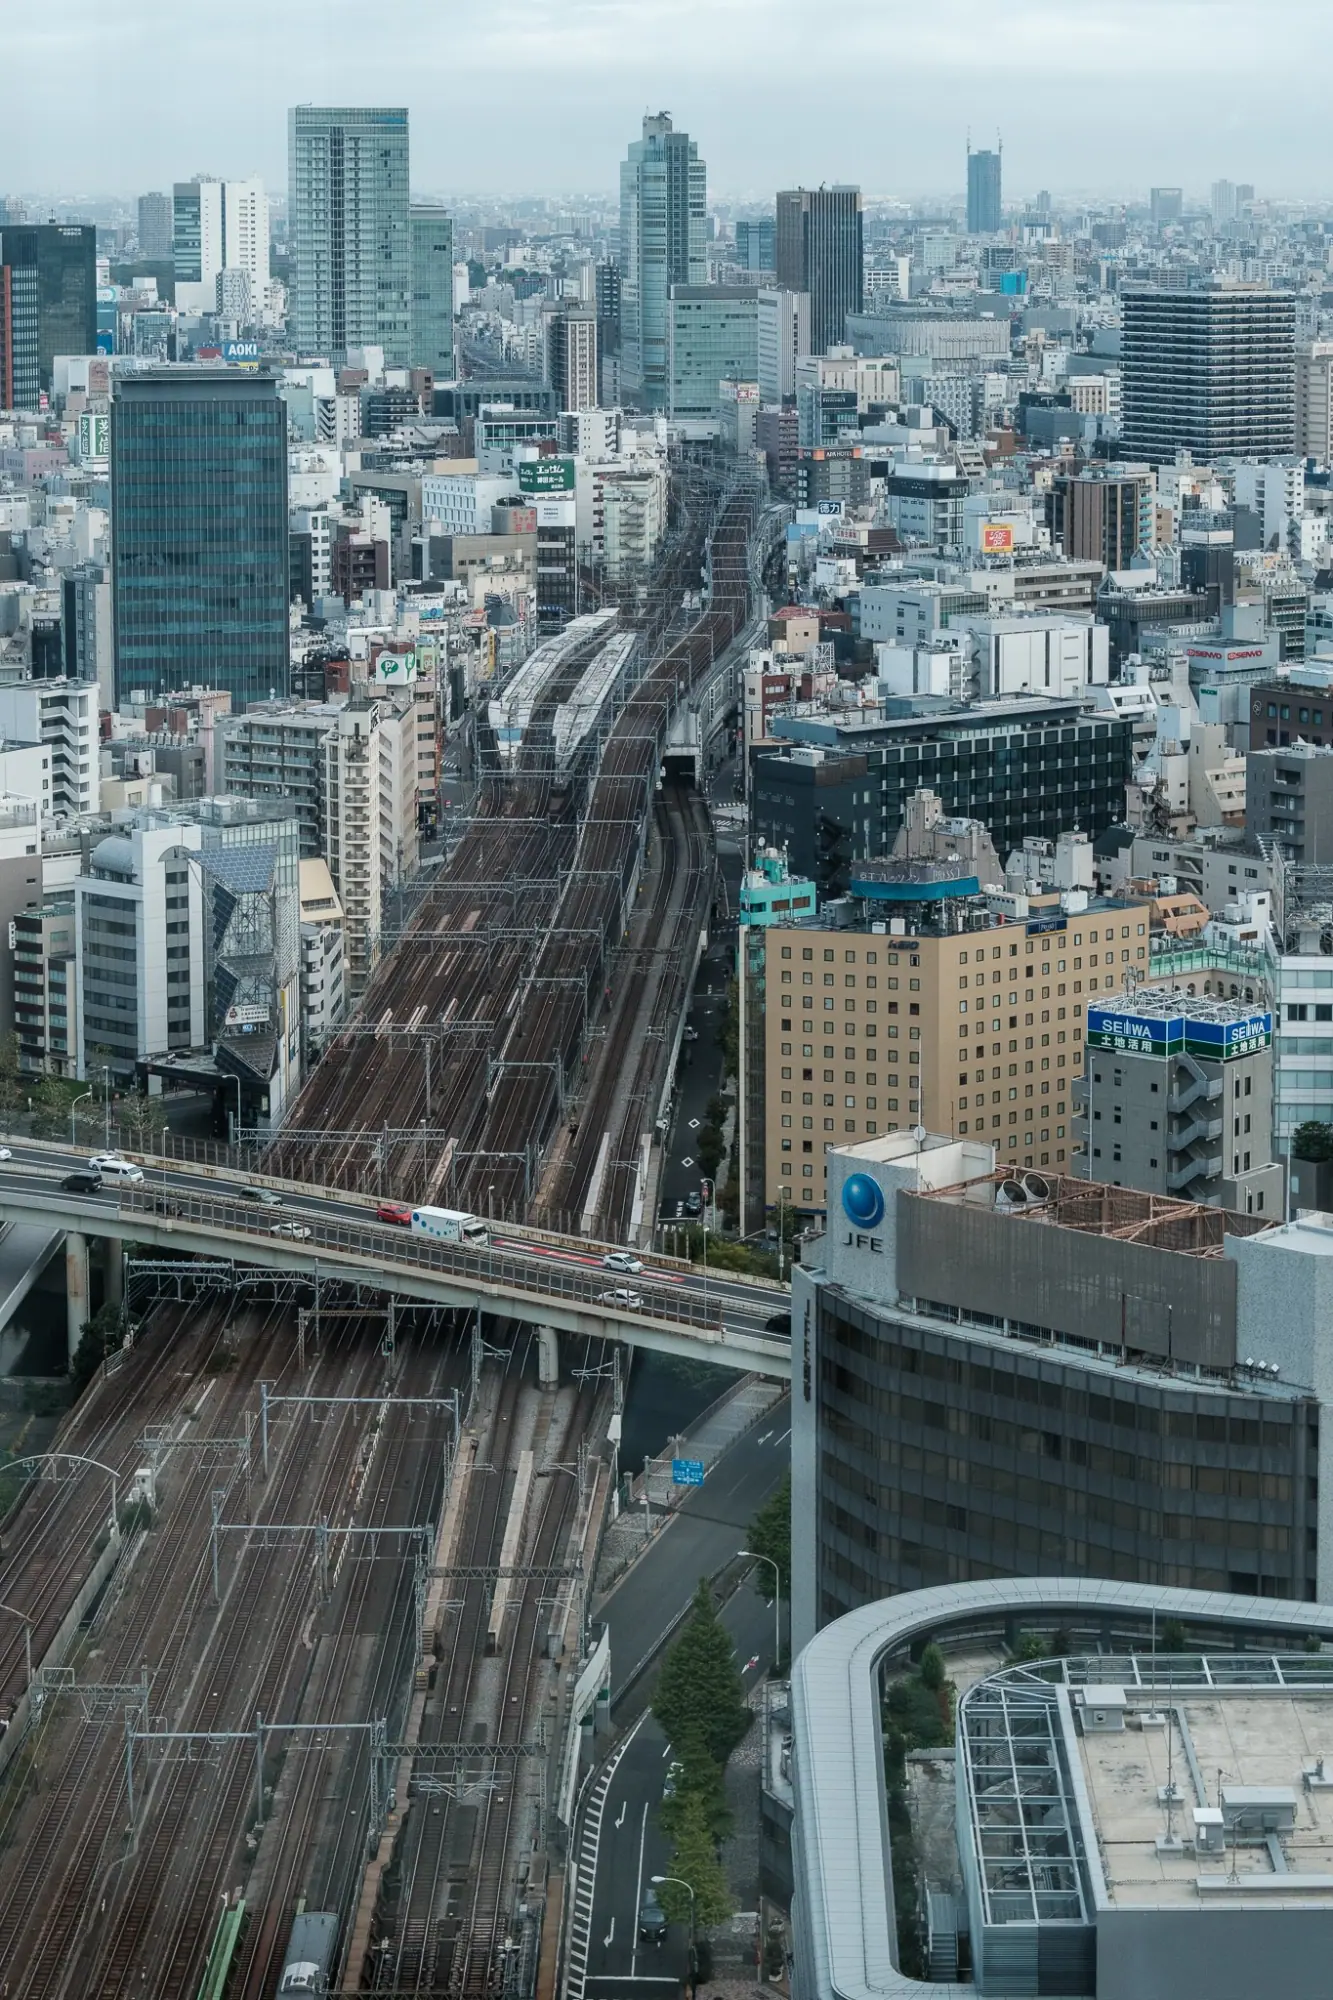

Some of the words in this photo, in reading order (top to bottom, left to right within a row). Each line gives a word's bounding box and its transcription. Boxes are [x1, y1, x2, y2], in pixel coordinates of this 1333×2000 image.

[228, 343, 257, 356] AOKI
[1101, 1035, 1152, 1053] 土地活用
[1231, 1036, 1266, 1056] 土地活用
[842, 1232, 884, 1254] JFE
